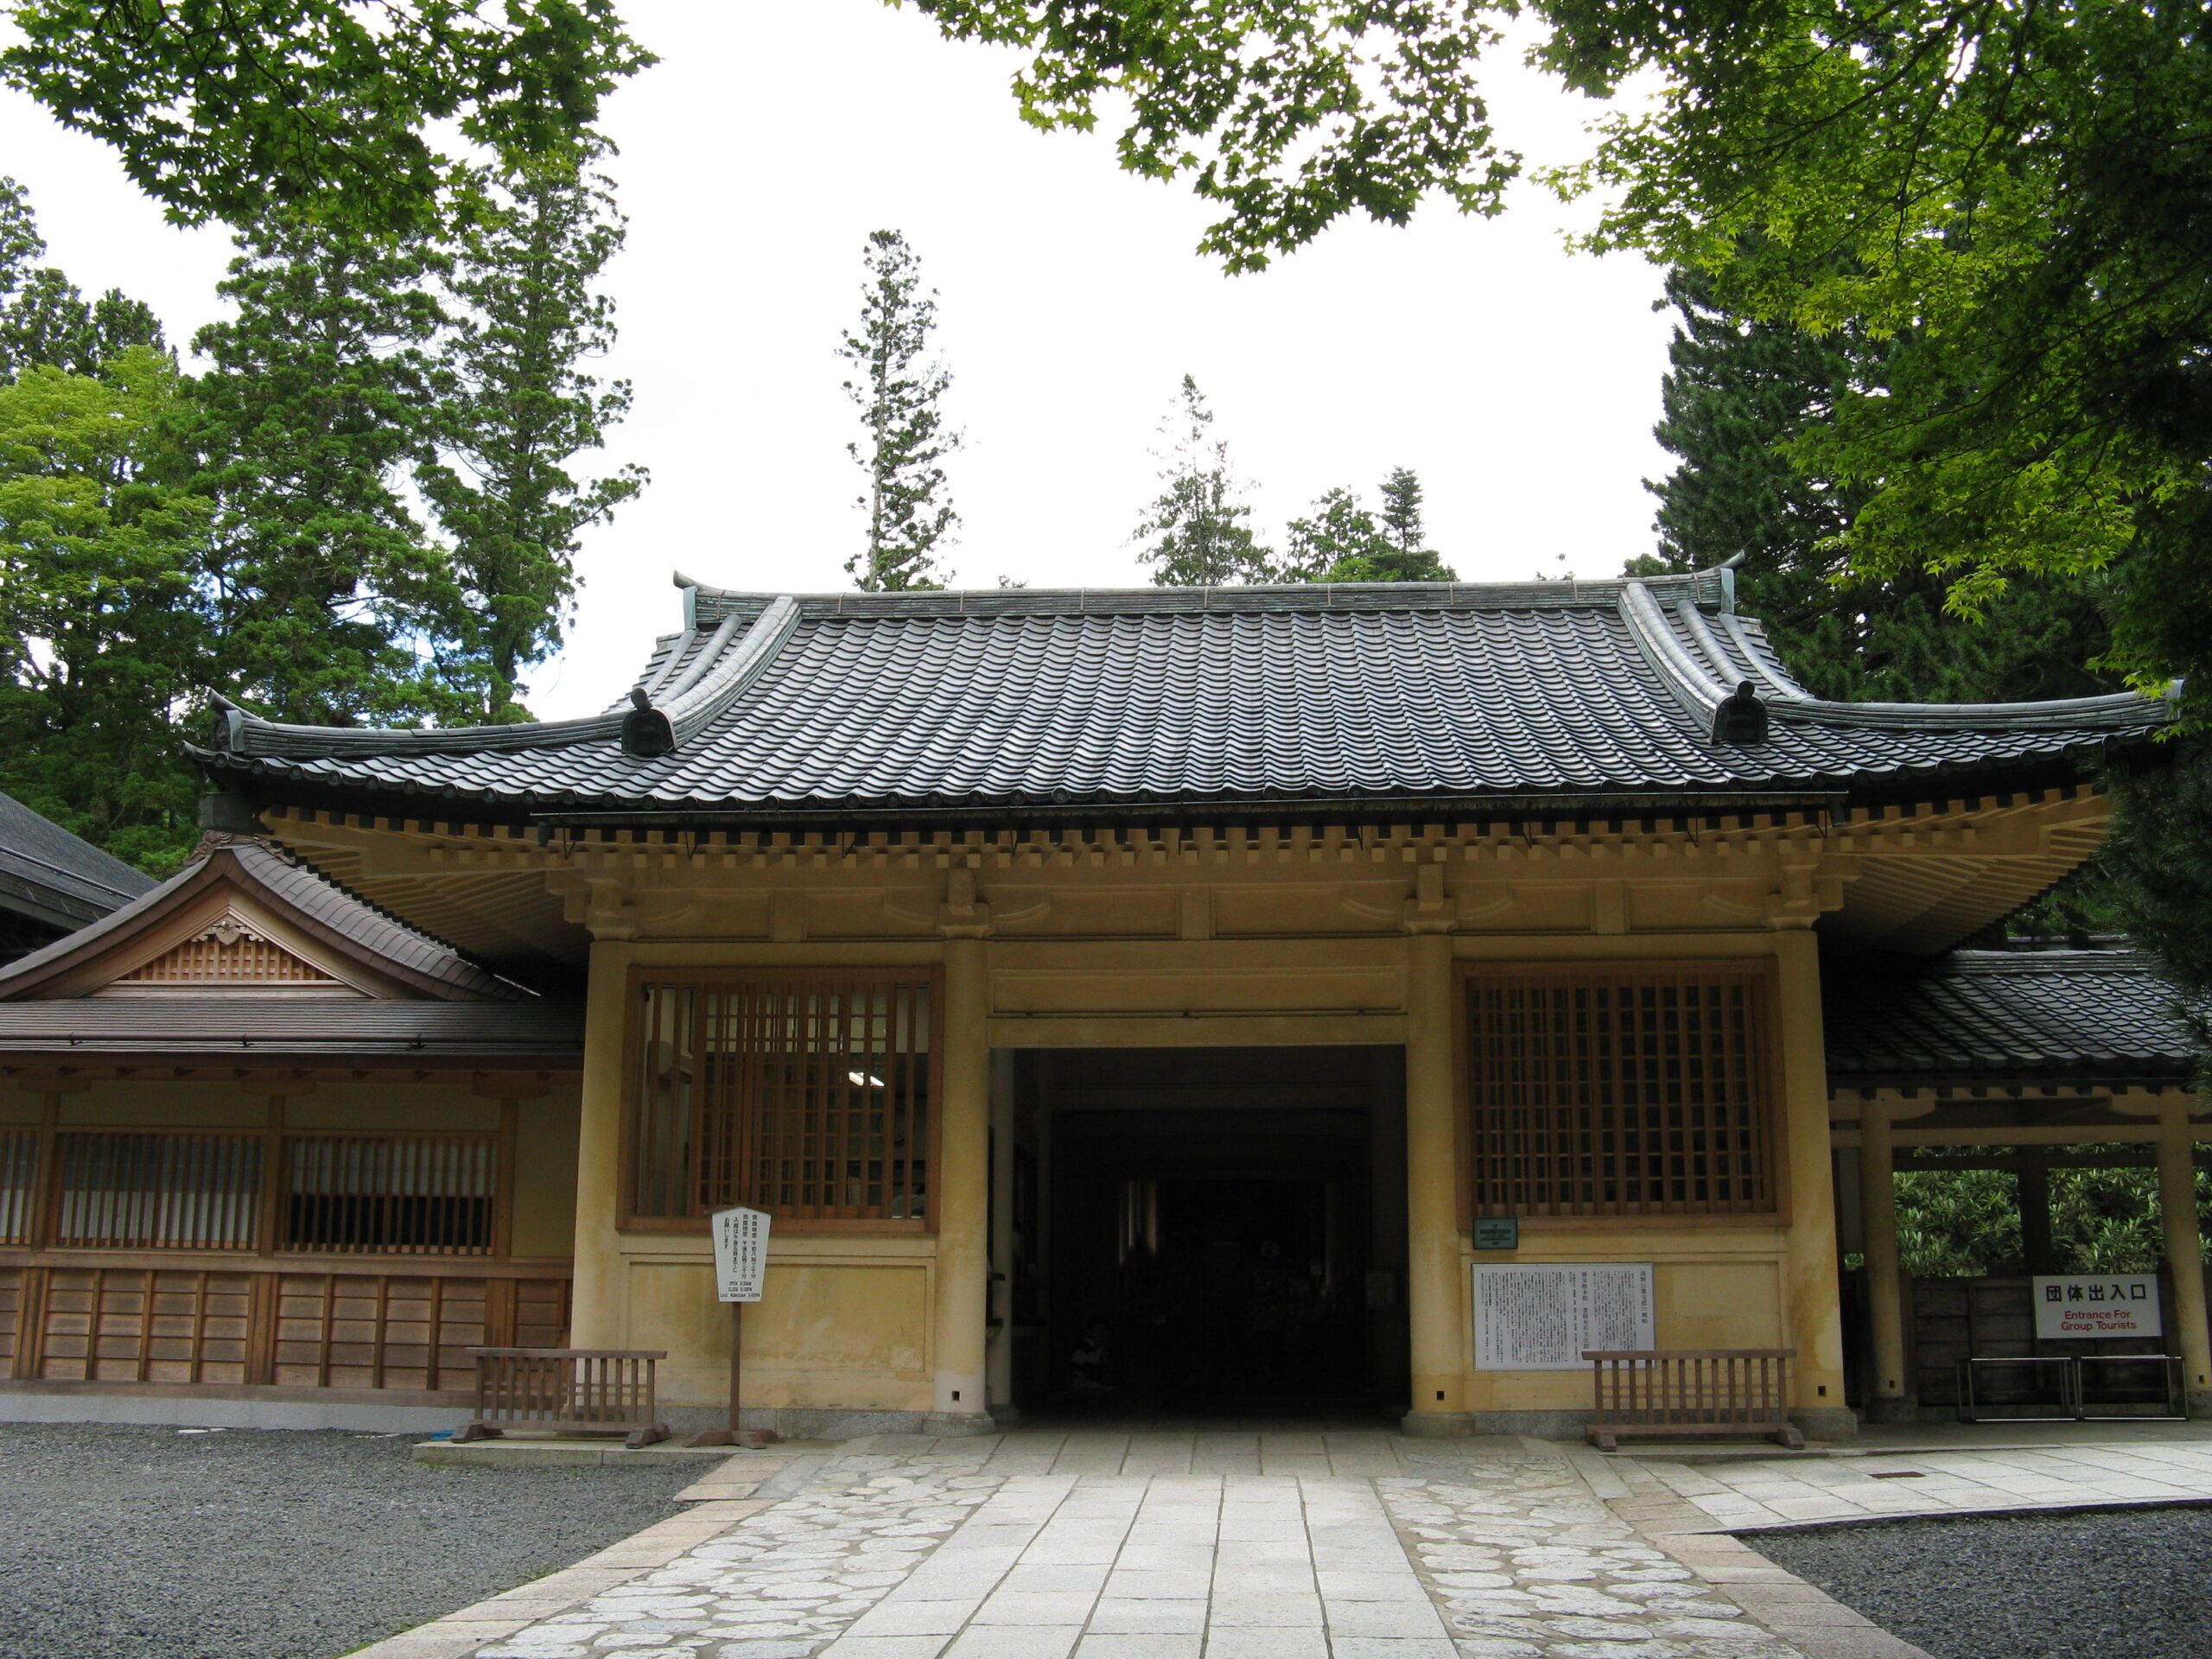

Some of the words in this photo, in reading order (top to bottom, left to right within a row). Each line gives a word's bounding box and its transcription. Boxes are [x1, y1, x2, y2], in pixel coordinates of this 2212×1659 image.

[2045, 1284, 2147, 1302] 団体出入口
[2064, 1310, 2111, 1319] Entrance
[2113, 1309, 2131, 1319] For
[2061, 1322, 2093, 1332] Group
[2095, 1321, 2137, 1330] Tourists
